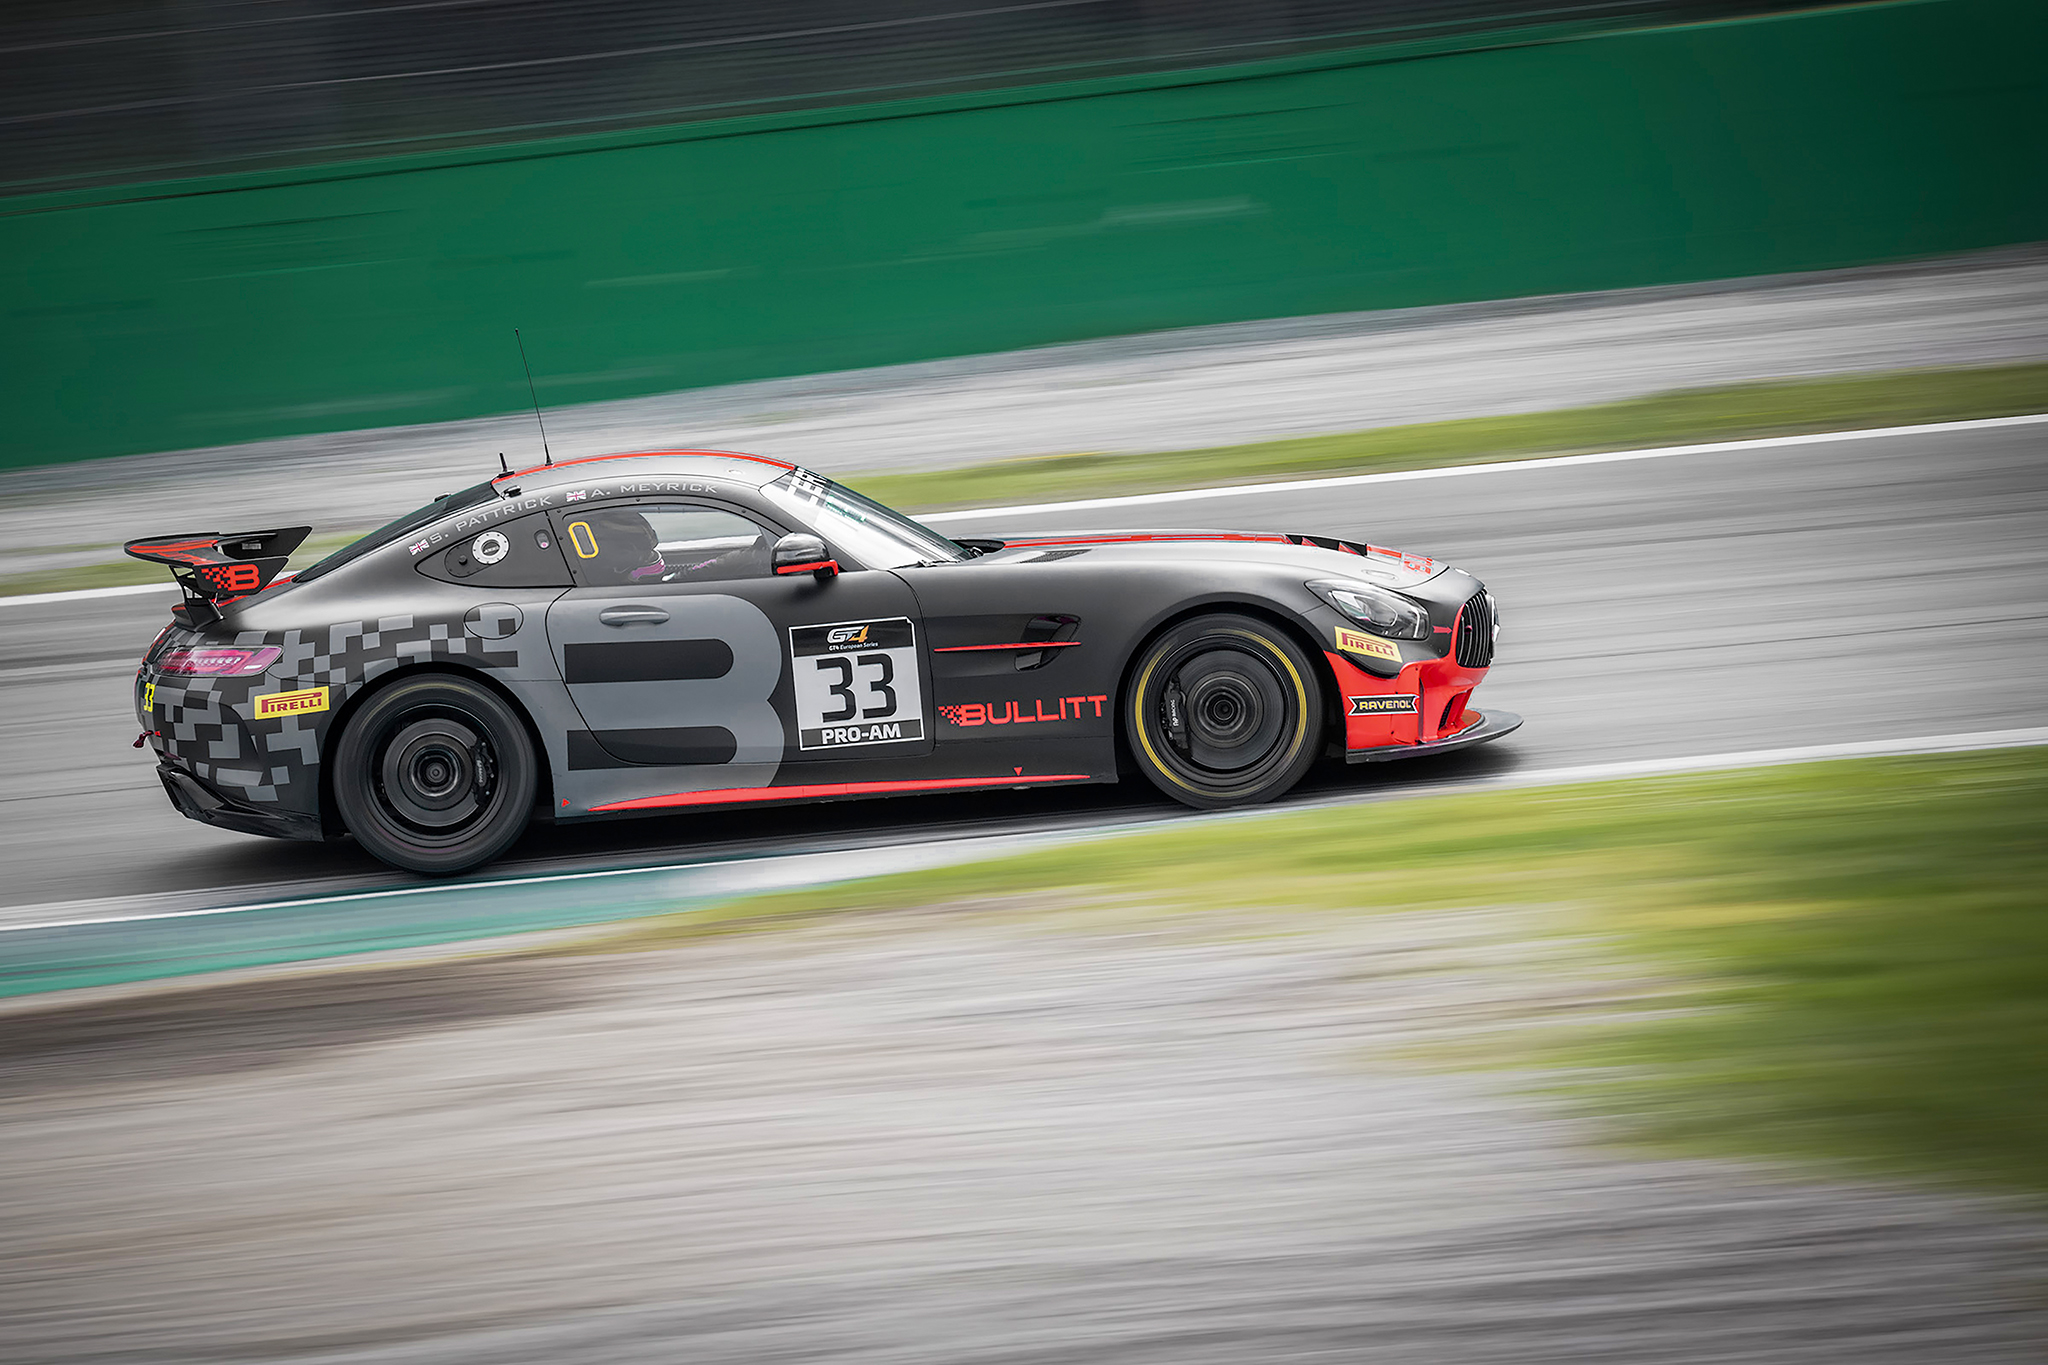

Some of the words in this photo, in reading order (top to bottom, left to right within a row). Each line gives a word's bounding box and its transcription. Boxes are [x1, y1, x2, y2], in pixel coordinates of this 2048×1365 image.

[590, 488, 611, 498] A.
[620, 482, 719, 494] MEYRICK
[429, 532, 450, 545] S.
[455, 495, 553, 532] PATTRICK
[827, 624, 870, 643] GT4
[840, 642, 863, 650] European
[863, 640, 879, 648] Series
[1341, 631, 1396, 657] PIRELLI
[143, 682, 156, 712] 33
[815, 652, 898, 723] 33
[261, 691, 322, 713] PIRELLI
[955, 694, 1108, 727] BULLITT
[1359, 700, 1412, 711] RAVENOL
[821, 722, 902, 745] PRO-AM
